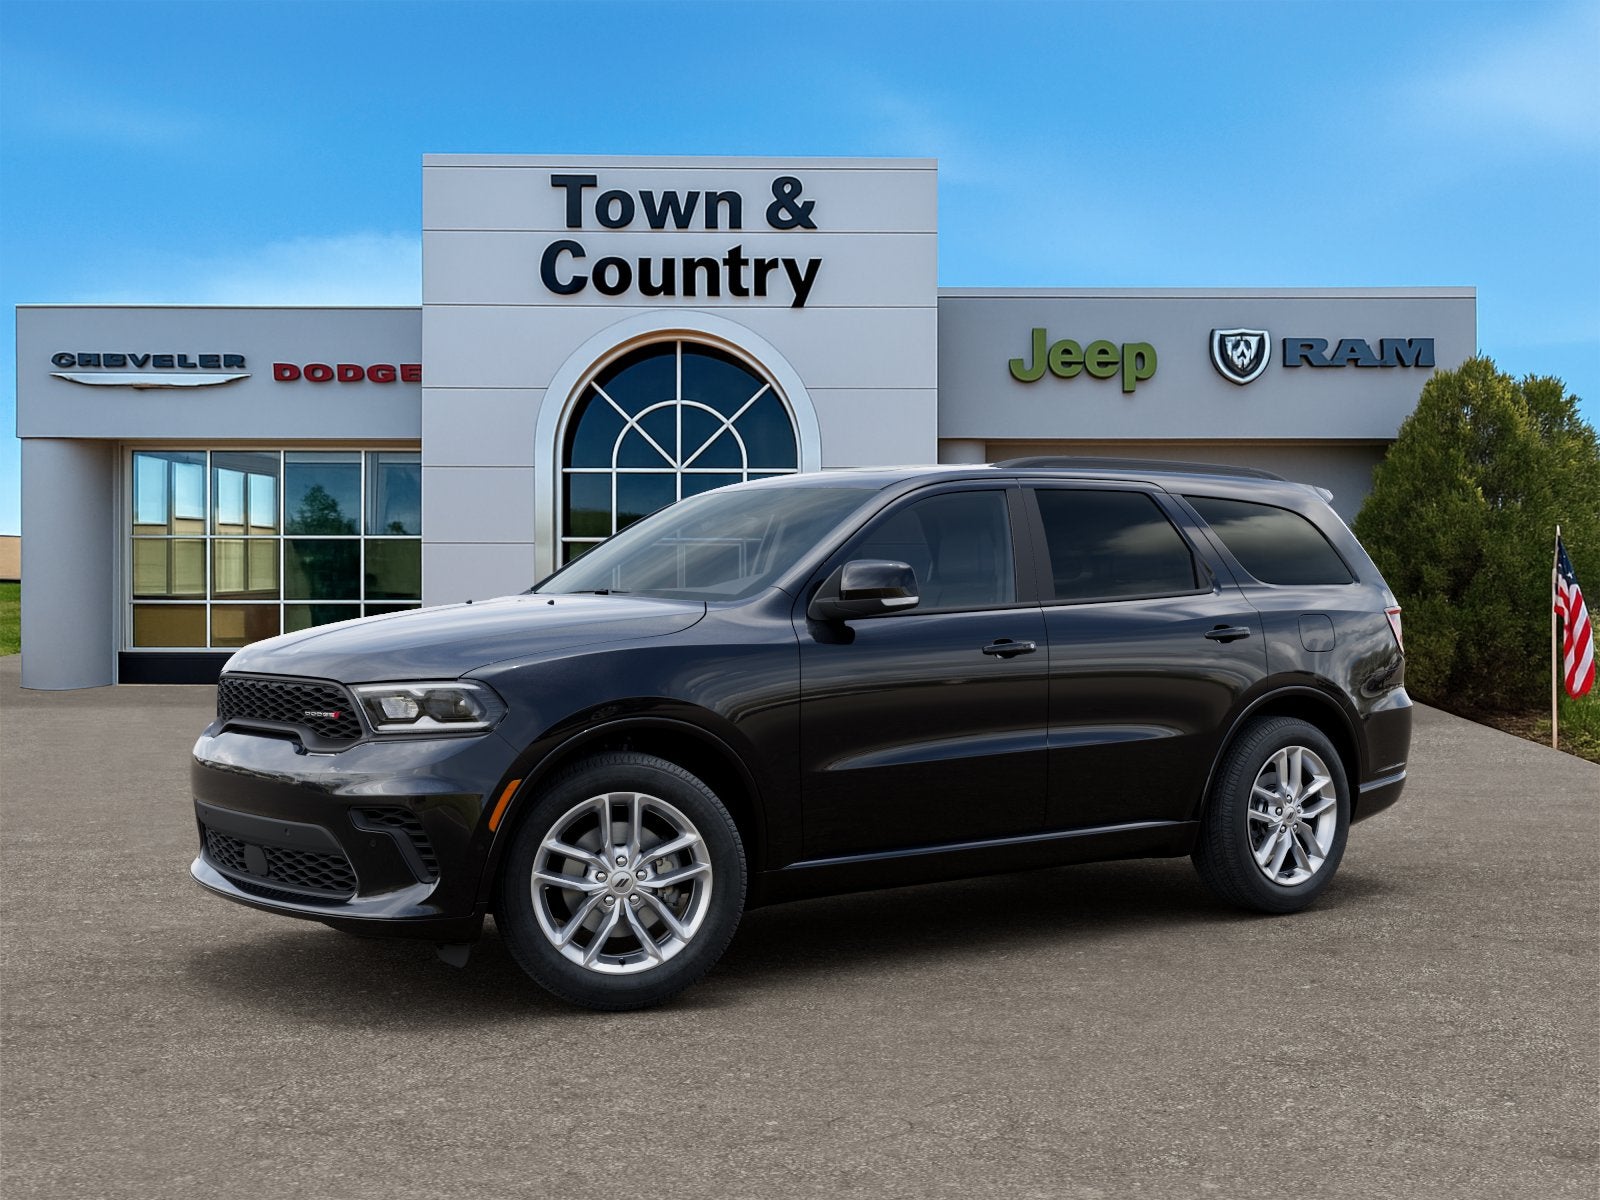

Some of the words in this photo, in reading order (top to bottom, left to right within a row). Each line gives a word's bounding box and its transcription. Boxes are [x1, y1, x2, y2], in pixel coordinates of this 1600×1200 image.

[550, 174, 743, 230] Town
[765, 175, 818, 230] &
[540, 239, 823, 309] Country
[273, 362, 422, 384] DODGE
[1009, 328, 1158, 393] Jeep
[1282, 337, 1436, 369] RAM
